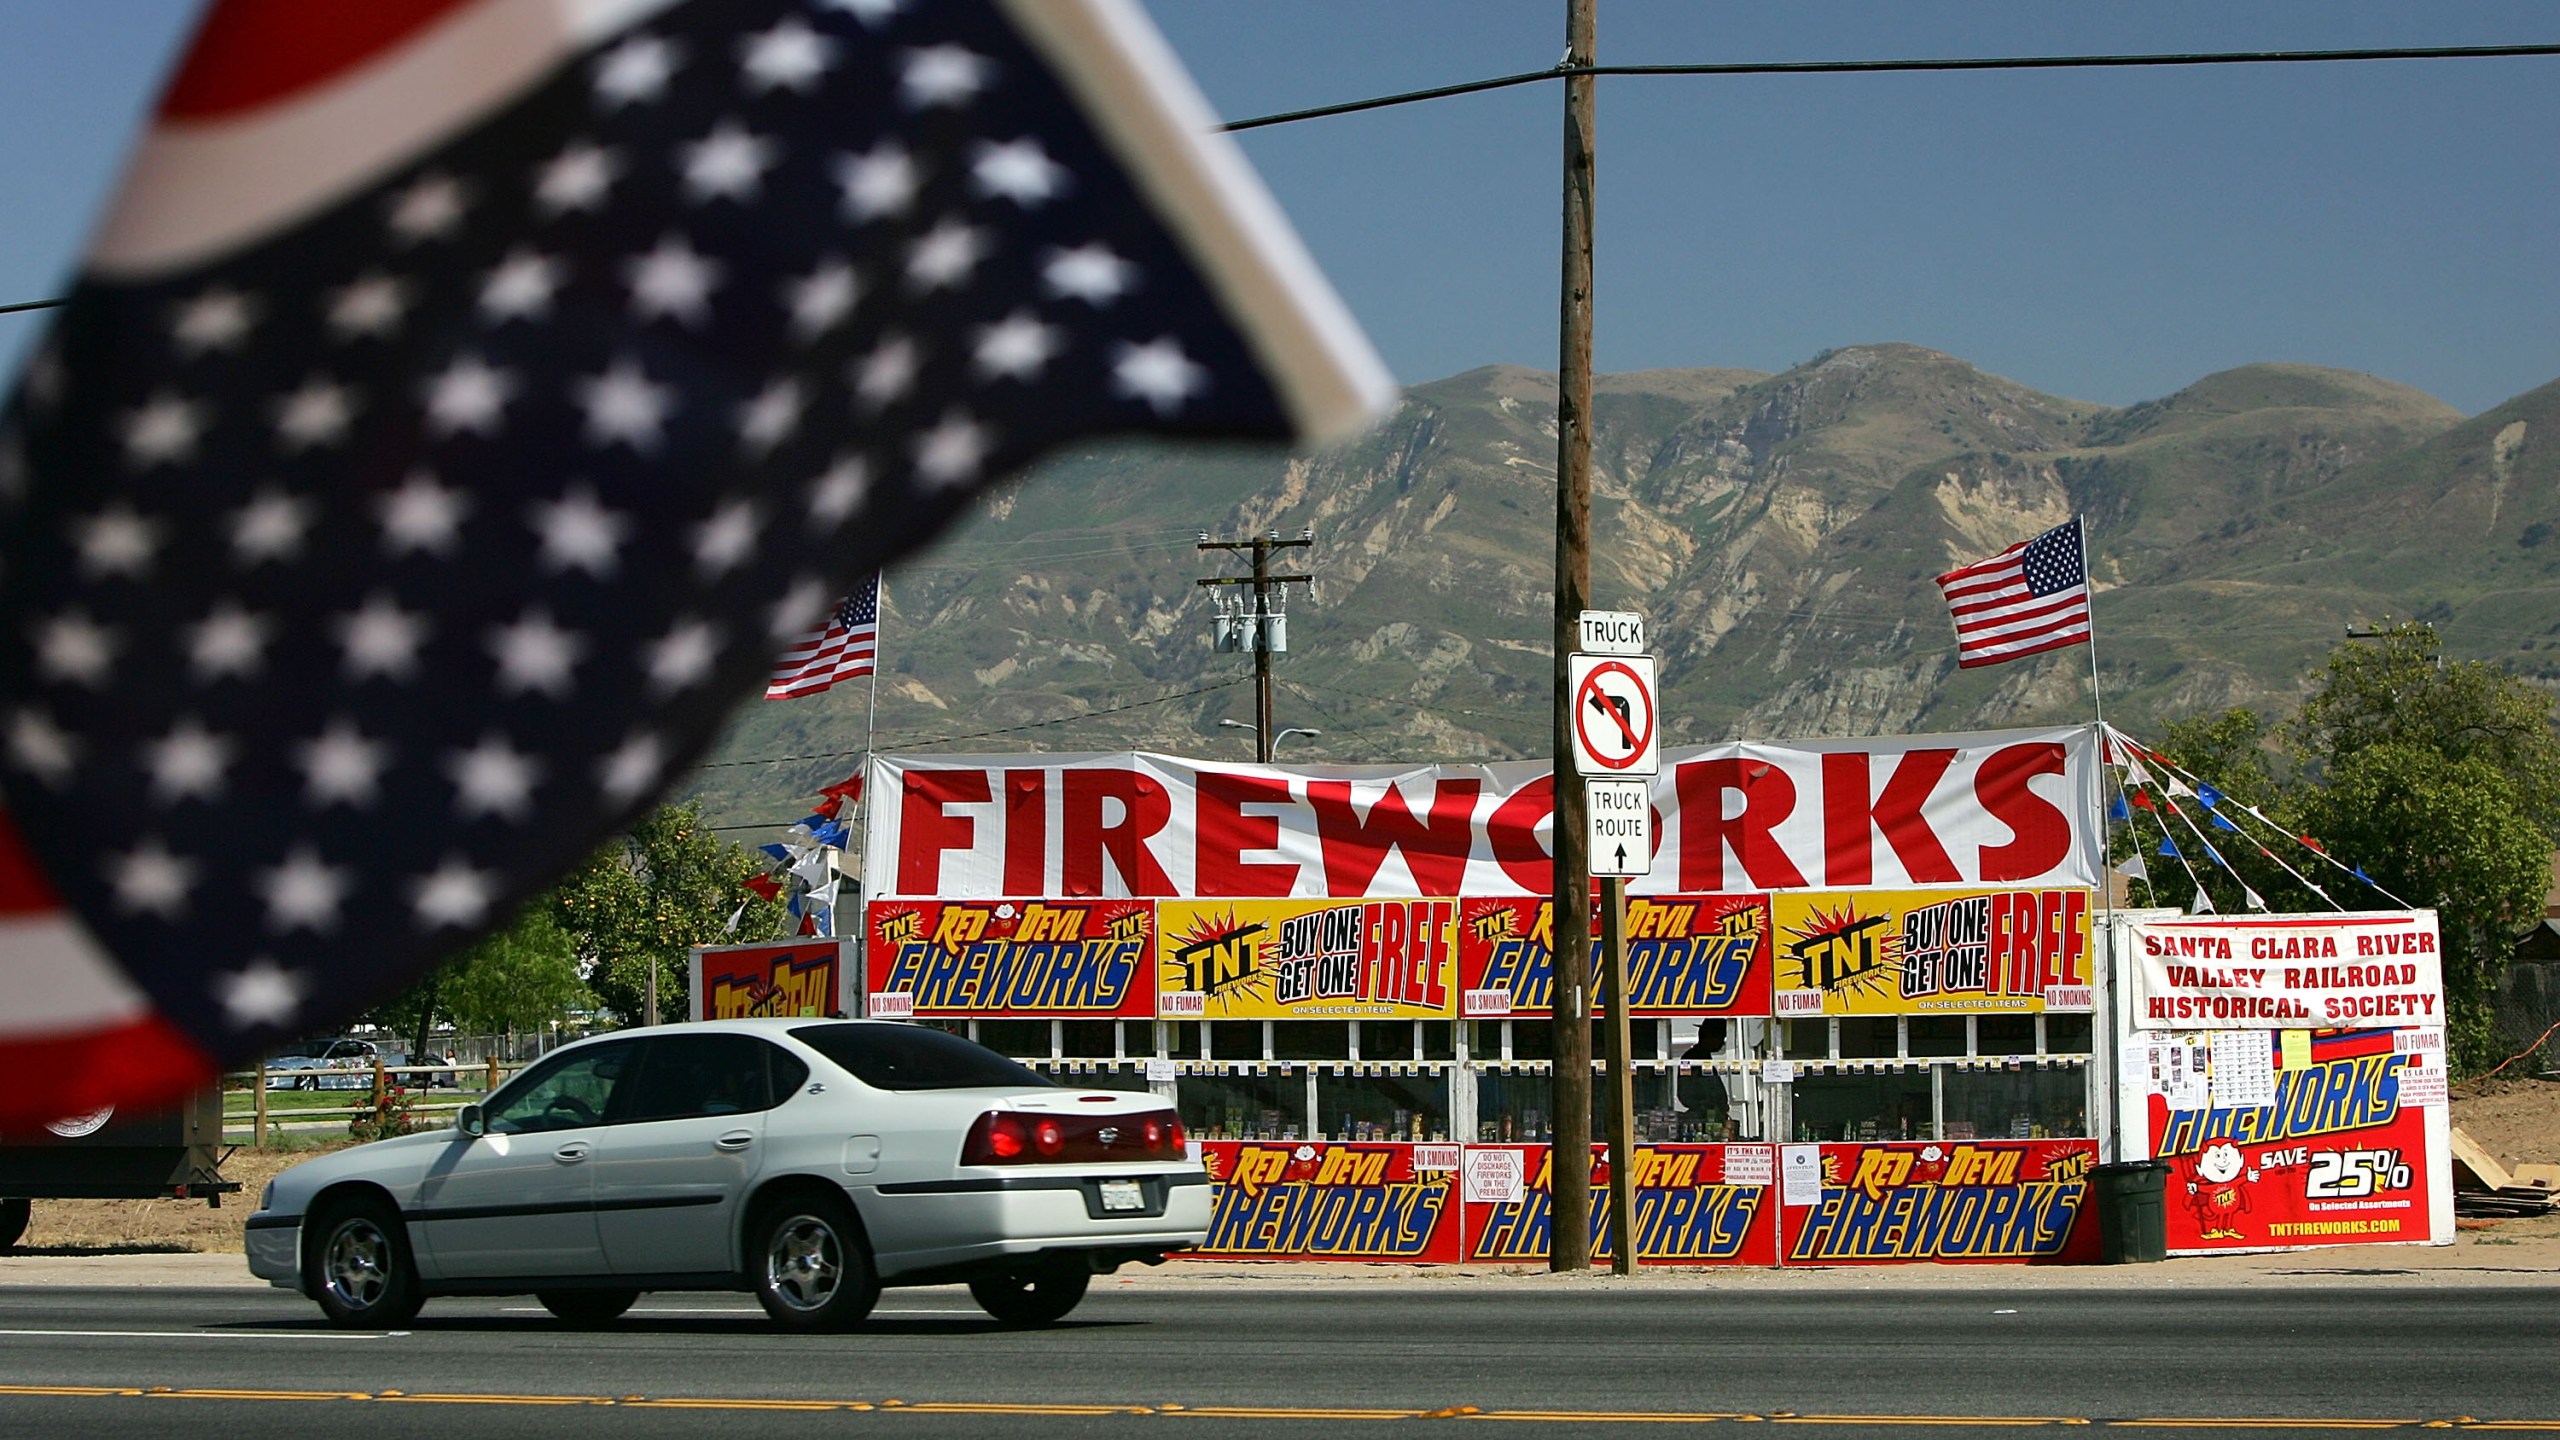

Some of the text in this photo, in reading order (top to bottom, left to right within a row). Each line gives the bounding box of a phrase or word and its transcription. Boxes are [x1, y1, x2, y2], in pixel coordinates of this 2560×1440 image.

[1583, 620, 1641, 644] TRUCK
[1594, 792, 1642, 810] TRUCK
[1595, 818, 1642, 837] ROUTE
[882, 913, 918, 941] TNT
[934, 903, 1087, 956] RED DEVIL
[1111, 913, 1146, 941] TNT
[1282, 908, 1360, 959] BUY ONE
[1476, 910, 1514, 940] TNT
[1721, 907, 1761, 937] TNT
[1905, 897, 1987, 952] BUY ONE
[1359, 901, 1452, 1008] FREE
[1803, 921, 1889, 987] TNT
[1987, 891, 2085, 997] FREE
[2146, 932, 2435, 959] SANTA CLARA RIVER
[1186, 929, 1267, 992] TNT
[1480, 935, 1758, 1009] FIRORKS
[1902, 946, 1985, 997] GET ONE
[884, 939, 1143, 1010] FIREWORKS
[1279, 955, 1356, 1001] GET ONE
[2167, 964, 2416, 989] VALLEY RAILROAD
[871, 996, 912, 1013] NO SMOKING
[1161, 995, 1203, 1011] NO FUMAR
[1292, 1006, 1394, 1014] ON SELECTED ITEMS
[1466, 993, 1509, 1011] NO SMOKING
[1778, 994, 1821, 1011] NO FUMAR
[1918, 1000, 2027, 1009] ON SELECTED ITEMS
[2046, 989, 2091, 1006] NO SMOKING
[2149, 994, 2436, 1019] HISTORICAL SOCIETY
[2396, 1035, 2408, 1050] NO
[2411, 1033, 2440, 1049] FUMAR
[1416, 1150, 1458, 1166] NO SMOKING
[1756, 1147, 1770, 1155] LAW
[2260, 1147, 2308, 1169] SAVE
[1231, 1147, 1289, 1198] RED
[1314, 1146, 1389, 1184] DEVIL
[1477, 1162, 1511, 1170] DISCHARGE
[1852, 1147, 1915, 1201] RED
[1942, 1145, 2027, 1185] DEVIL
[2050, 1152, 2090, 1182] TNT
[2306, 1149, 2410, 1198] 25%
[1479, 1188, 1509, 1196] PREMISES
[2216, 1189, 2235, 1204] TNT
[2309, 1200, 2411, 1211] On Selected Assortments
[1192, 1181, 1449, 1255] IREWORKS
[1473, 1186, 1762, 1257] FIRORKS
[1791, 1182, 2086, 1259] FIREWORKS
[2269, 1219, 2400, 1237] TNTFIREWORKS.COM
